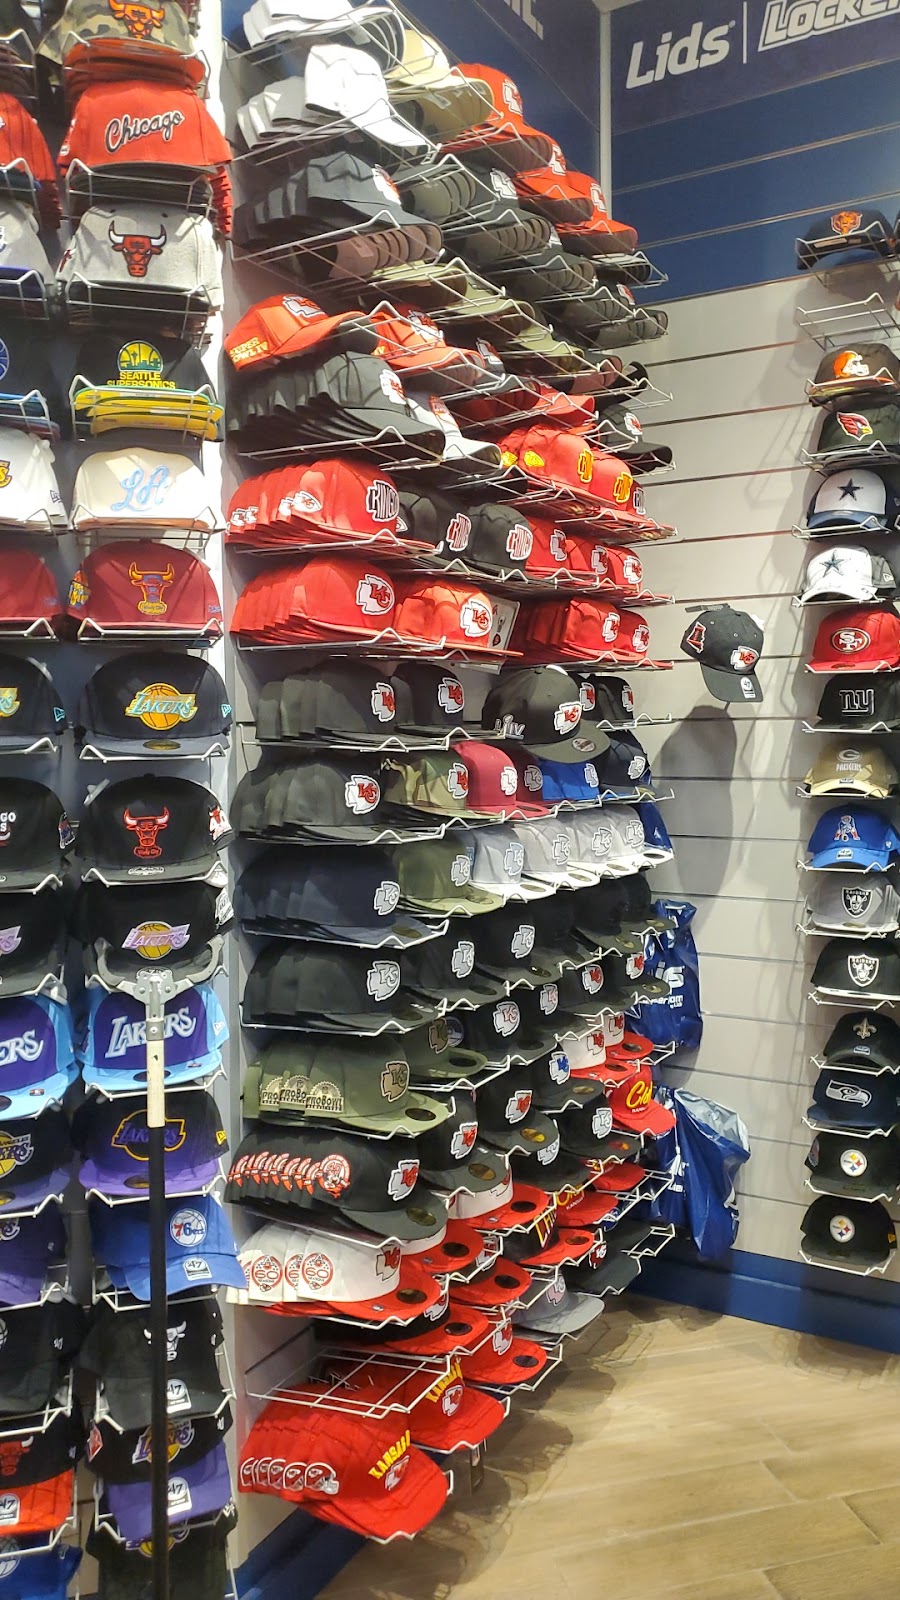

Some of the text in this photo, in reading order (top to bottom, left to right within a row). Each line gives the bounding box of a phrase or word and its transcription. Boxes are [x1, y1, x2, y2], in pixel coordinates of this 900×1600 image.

[758, 0, 900, 52] LOCKE
[626, 21, 731, 90] Lids
[105, 109, 185, 153] Chicago
[106, 380, 176, 390] SUPERSONICS
[119, 371, 162, 381] SEATTLE
[839, 631, 863, 651] SF
[130, 692, 195, 719] LAKERS
[126, 930, 187, 950] LAKERS
[105, 1006, 197, 1060] LAKRS
[0, 1029, 44, 1067] ERS
[117, 1122, 177, 1147] LAKS
[255, 1270, 279, 1280] 60
[305, 1267, 329, 1279] 60
